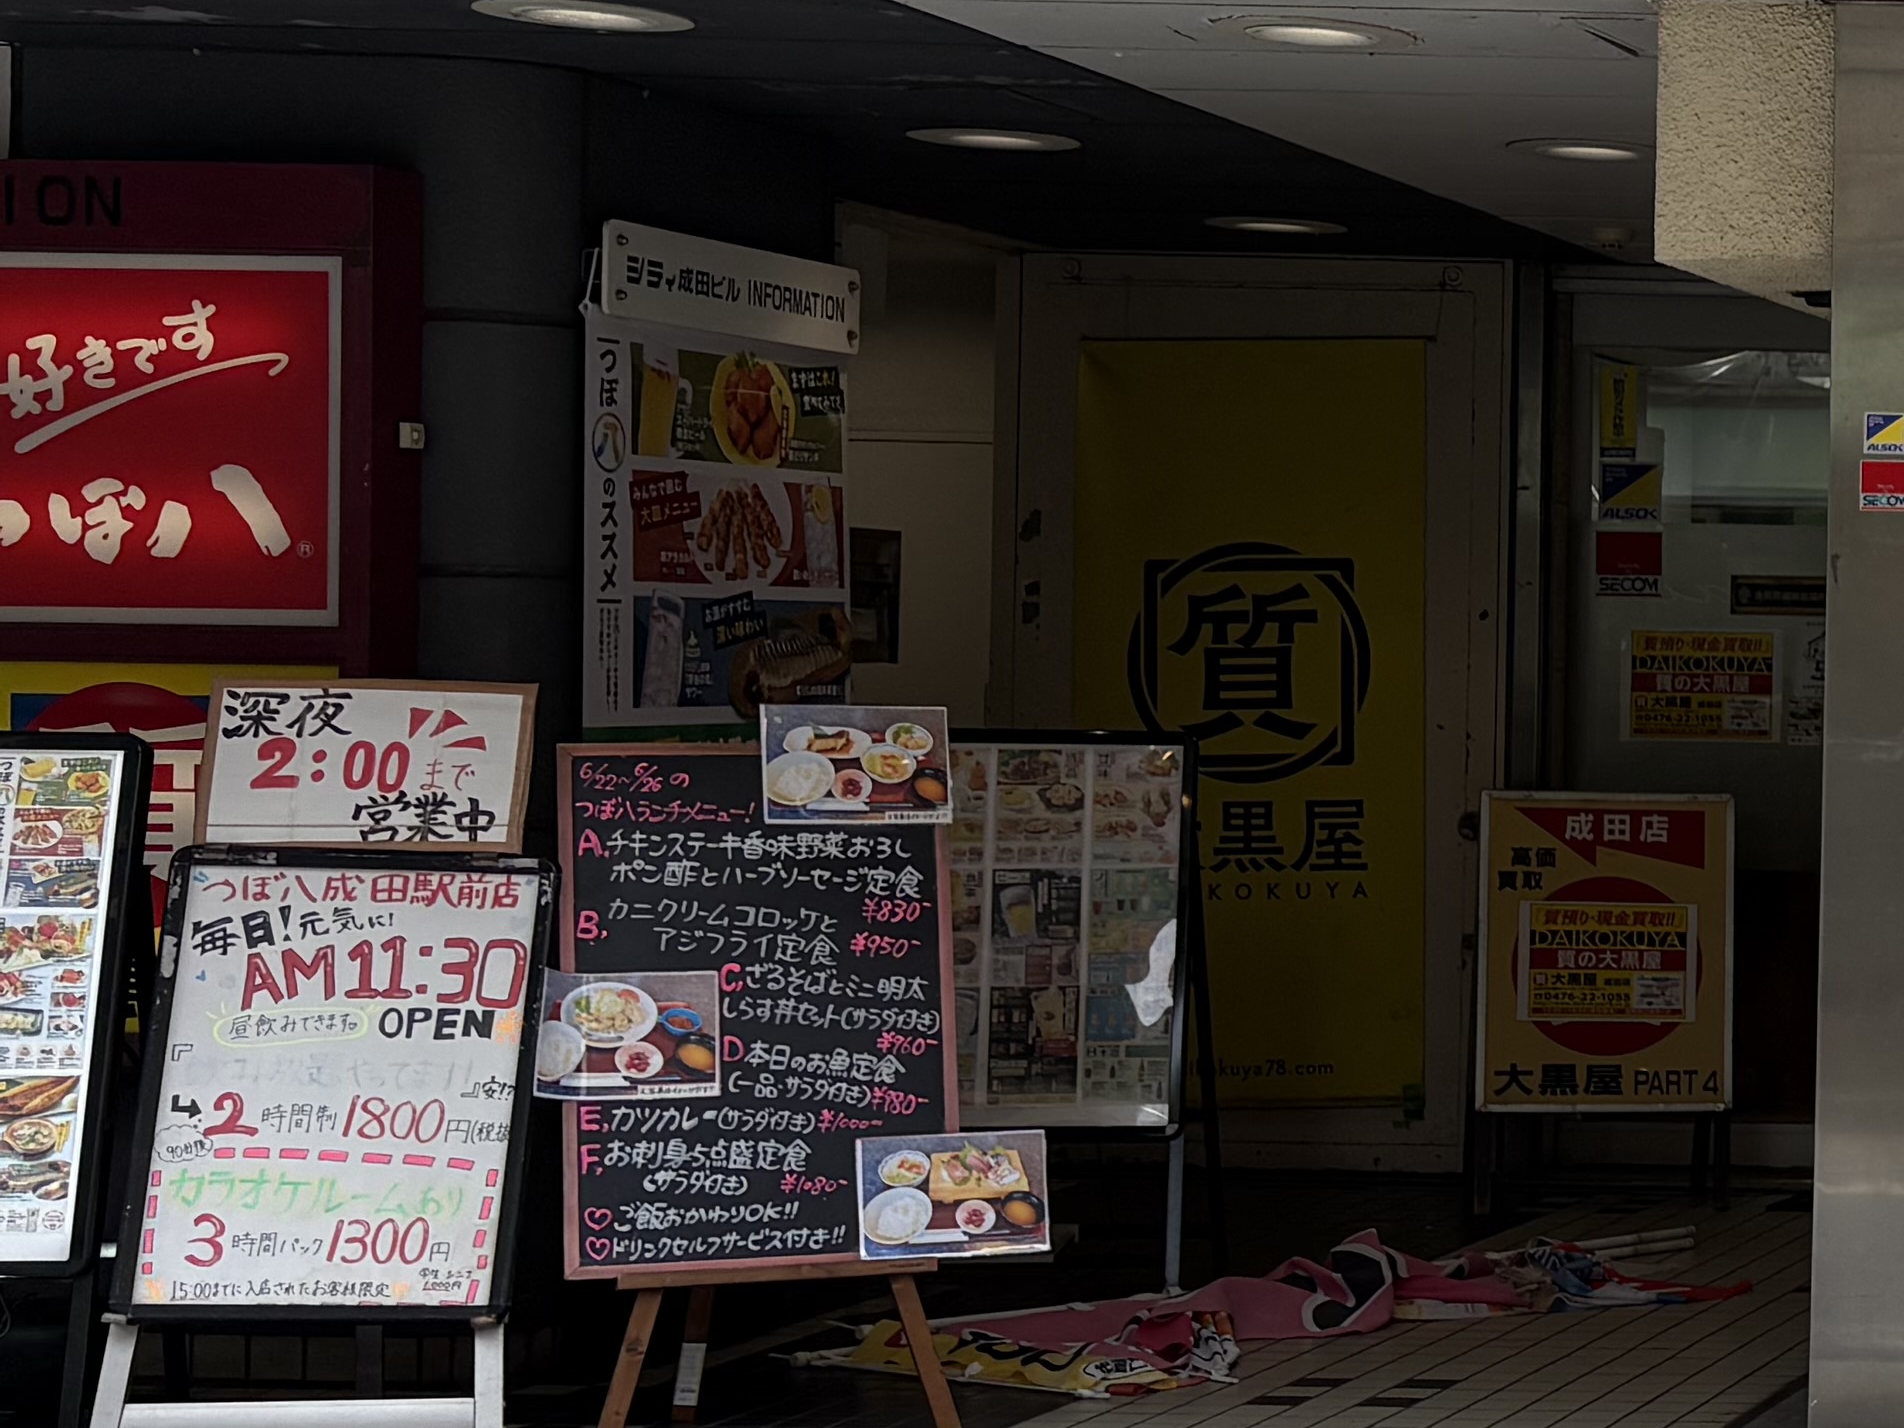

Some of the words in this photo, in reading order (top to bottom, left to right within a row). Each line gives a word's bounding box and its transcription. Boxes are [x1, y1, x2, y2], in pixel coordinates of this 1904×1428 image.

[748, 279, 845, 322] INFORMATION
[0, 299, 216, 420] 好きです
[1867, 443, 1903, 452] ALSOK
[1602, 508, 1658, 519] ALSOK
[1599, 577, 1658, 592] SECOM
[1167, 583, 1317, 740] 質
[1636, 656, 1767, 671] DAIKOKUYA
[222, 689, 353, 739] 深夜
[250, 737, 410, 793] 2:00
[420, 758, 475, 791] まで
[352, 791, 496, 842] 営業中
[1565, 813, 1669, 843] 成田店
[1197, 799, 1368, 872] 黒屋
[1511, 847, 1556, 867] 高価
[202, 873, 521, 908] つぼ八成田駅前店
[1498, 871, 1543, 890] 買取
[653, 926, 839, 965] アジフライ定食
[1535, 931, 1681, 947] DAIKOKUYA
[379, 1008, 496, 1040] OPEN
[1494, 1064, 1623, 1095] 大黒屋
